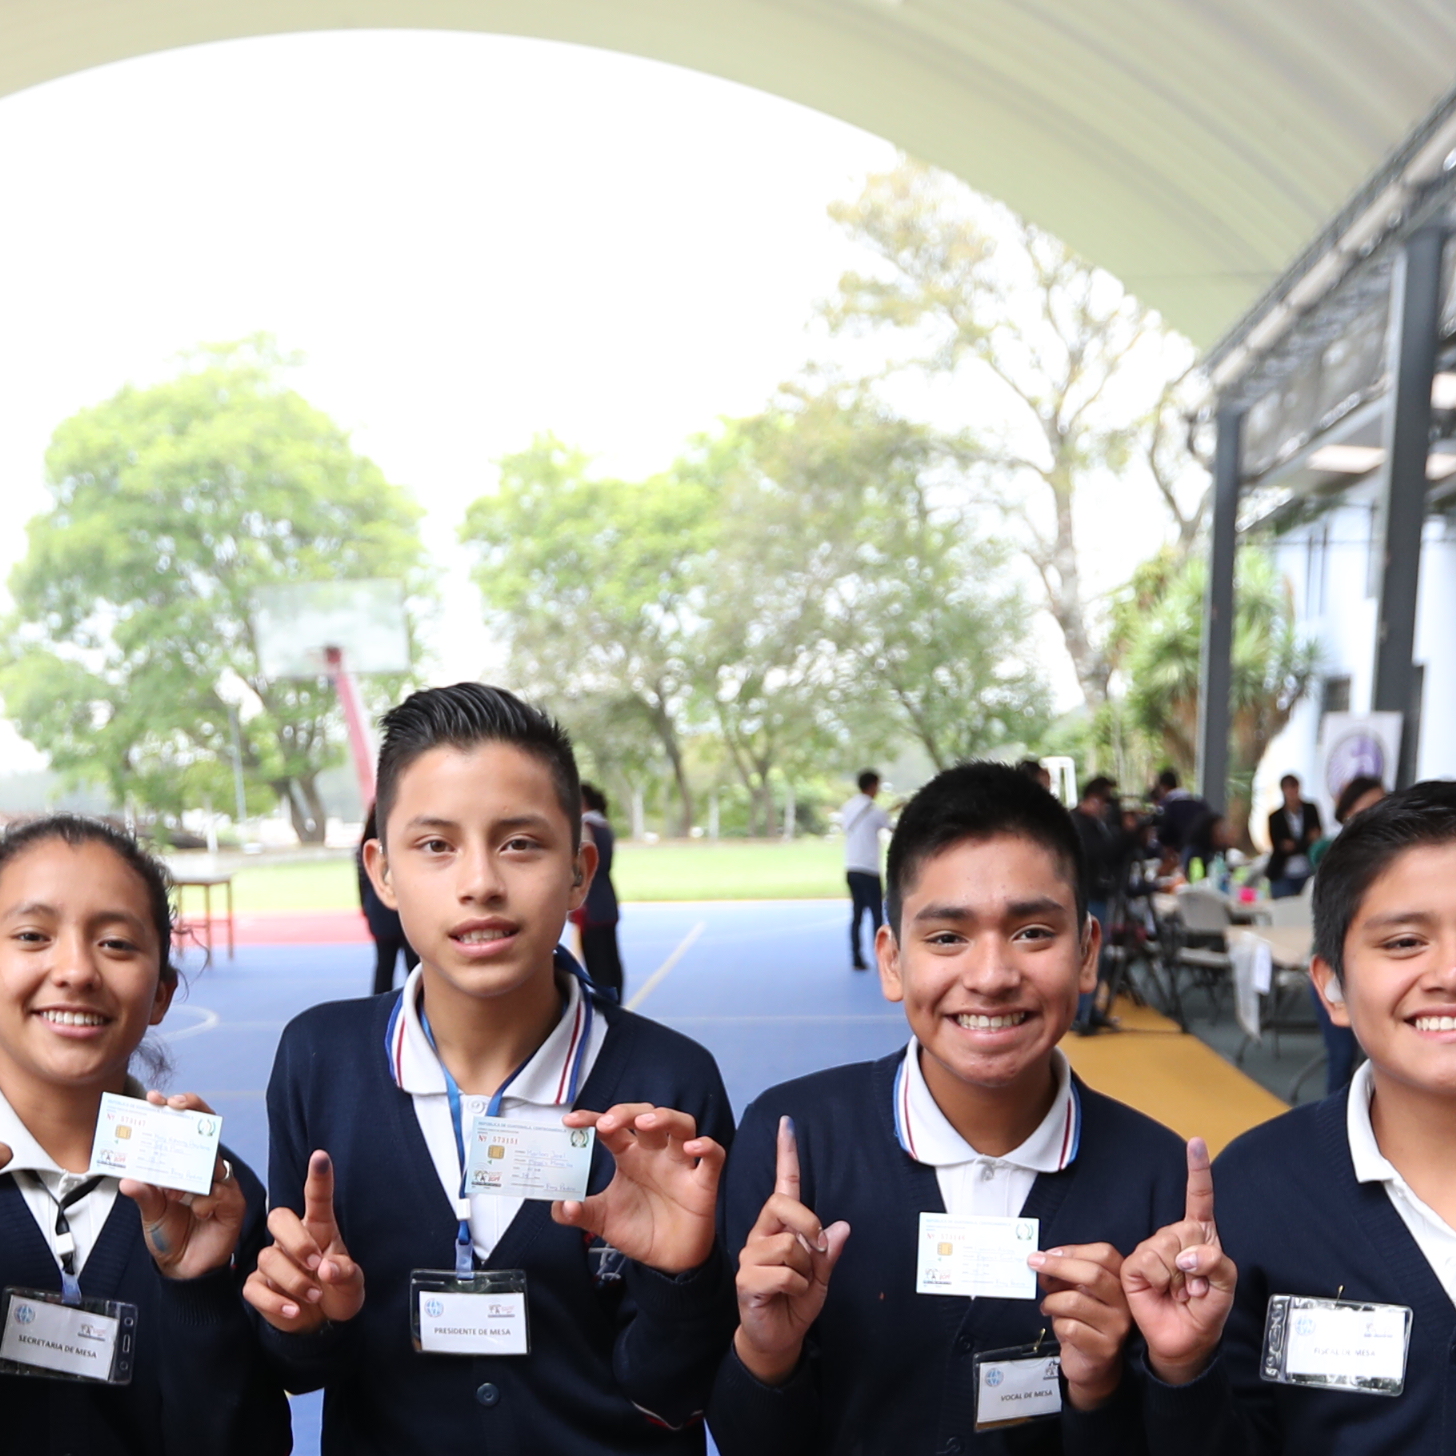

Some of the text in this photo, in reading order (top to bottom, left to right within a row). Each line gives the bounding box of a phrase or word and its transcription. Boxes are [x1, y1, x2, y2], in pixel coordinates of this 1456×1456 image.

[434, 1327, 511, 1336] PRESIDENTE DE MESA
[18, 1334, 97, 1359] SECRETARIA DE MESA
[1314, 1347, 1339, 1356] FISCAL
[1355, 1349, 1376, 1357] MESA
[1001, 1390, 1053, 1401] VOCAL DE MESA
